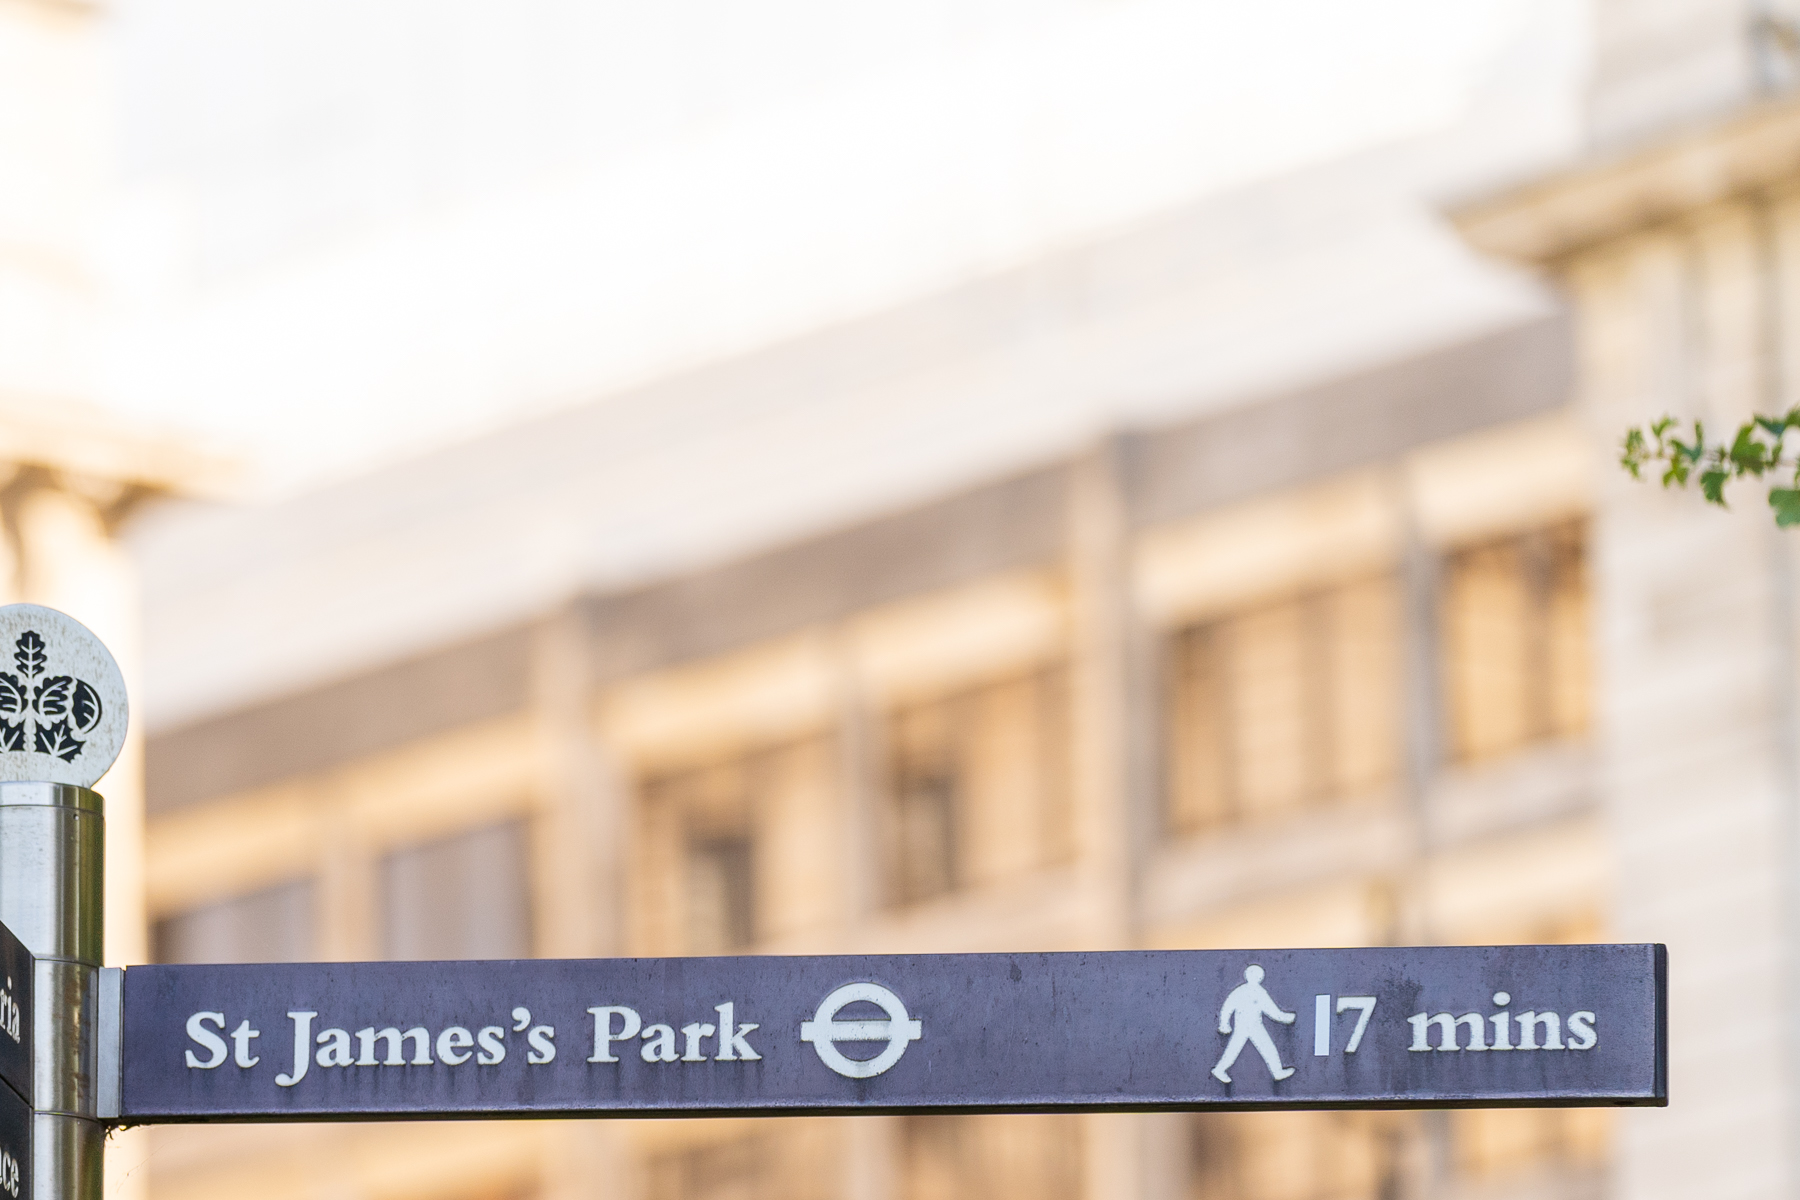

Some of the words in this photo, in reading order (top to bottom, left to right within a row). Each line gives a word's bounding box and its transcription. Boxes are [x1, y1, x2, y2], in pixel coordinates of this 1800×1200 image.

[185, 1011, 260, 1069] St
[586, 1001, 763, 1063] Park
[1407, 991, 1598, 1053] mins
